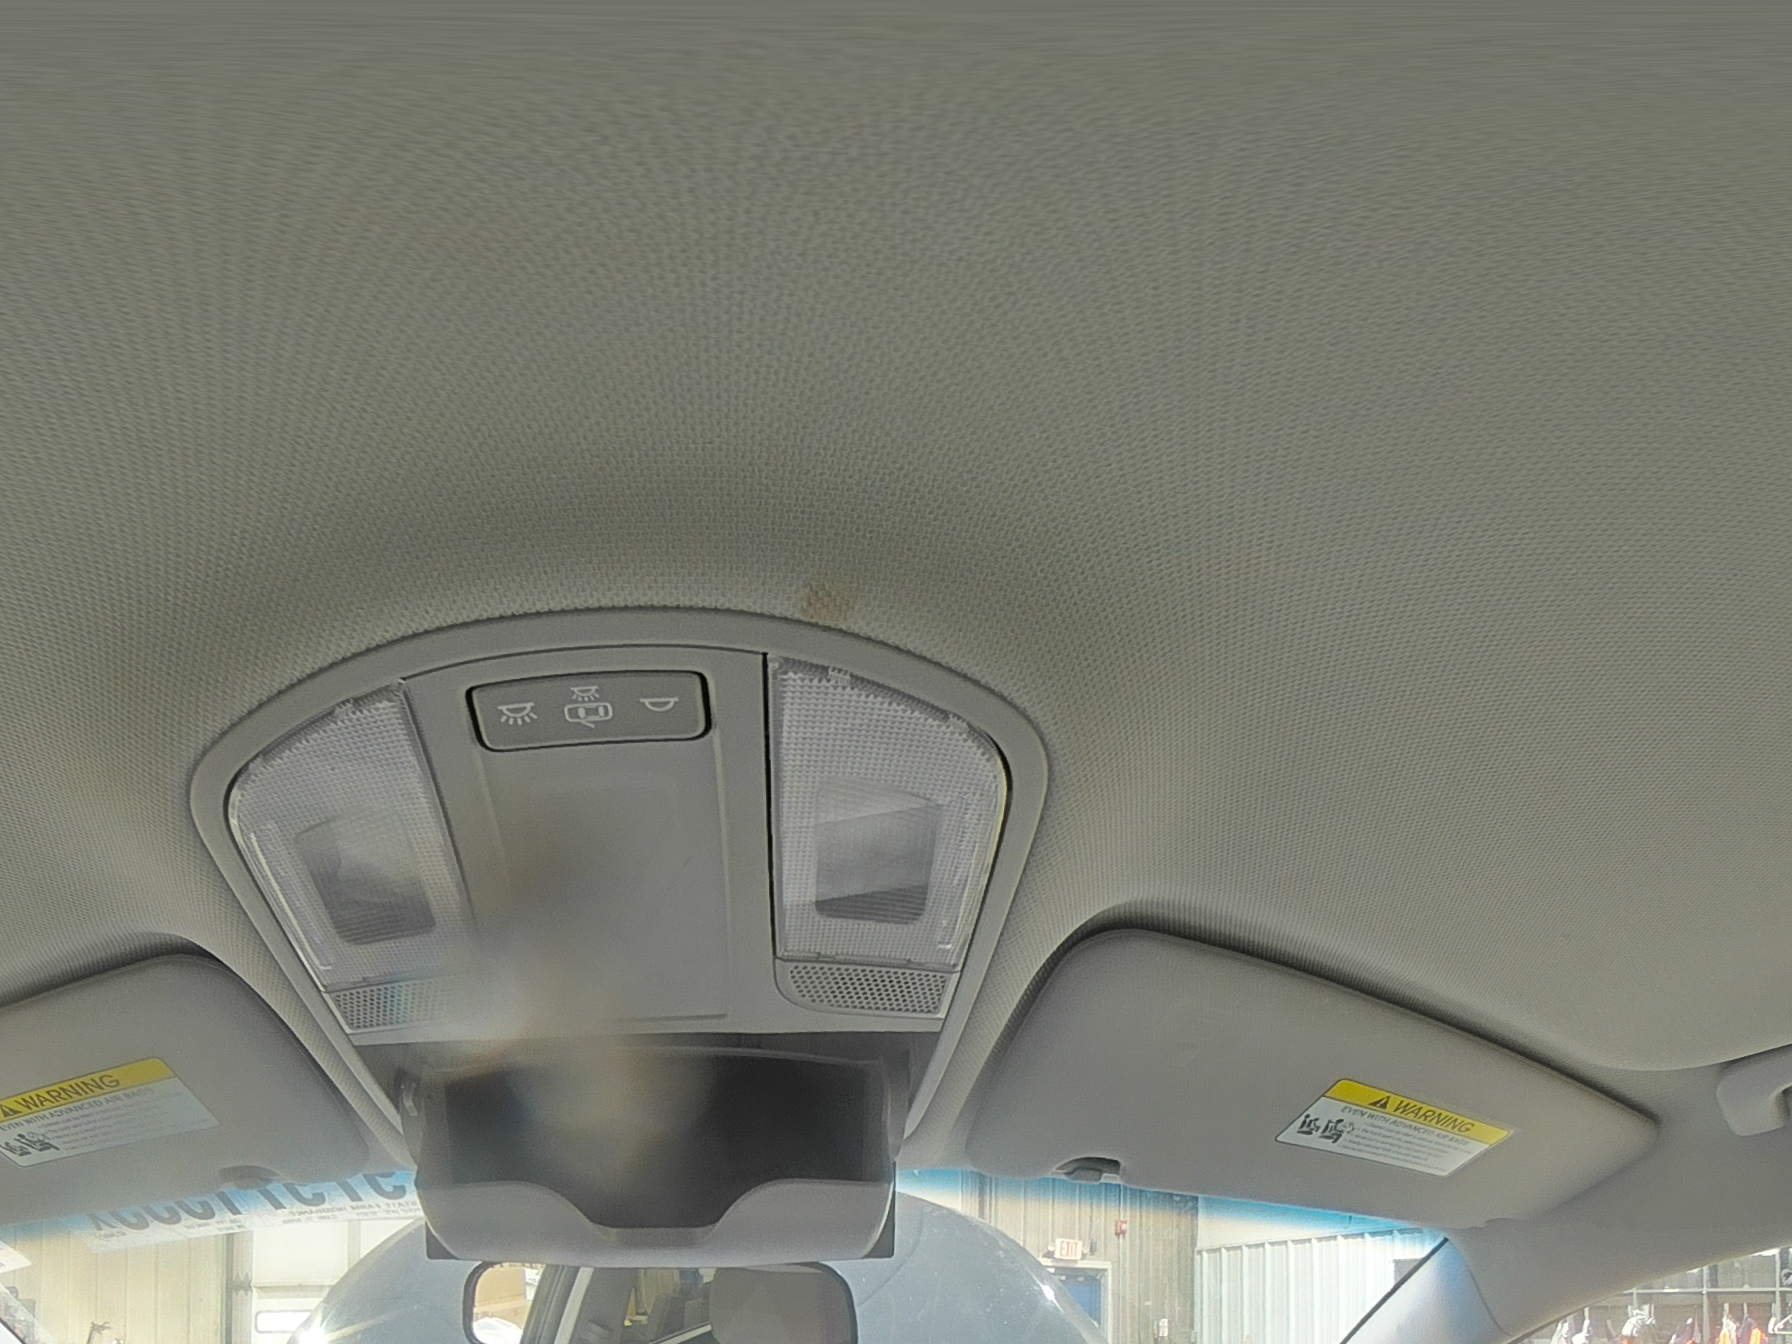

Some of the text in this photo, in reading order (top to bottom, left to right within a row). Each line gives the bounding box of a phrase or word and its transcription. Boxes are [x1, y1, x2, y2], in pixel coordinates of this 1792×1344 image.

[14, 1073, 121, 1112] WARNING
[23, 1113, 48, 1126] WITH
[47, 1099, 102, 1121] ADVANCED
[104, 1094, 122, 1106] AIR
[1340, 1105, 1366, 1119] EVEN
[1366, 1111, 1390, 1125] WITH
[1390, 1117, 1436, 1137] ADVANCED
[1393, 1099, 1475, 1134] WARNING
[1060, 1240, 1079, 1258] EXIT
